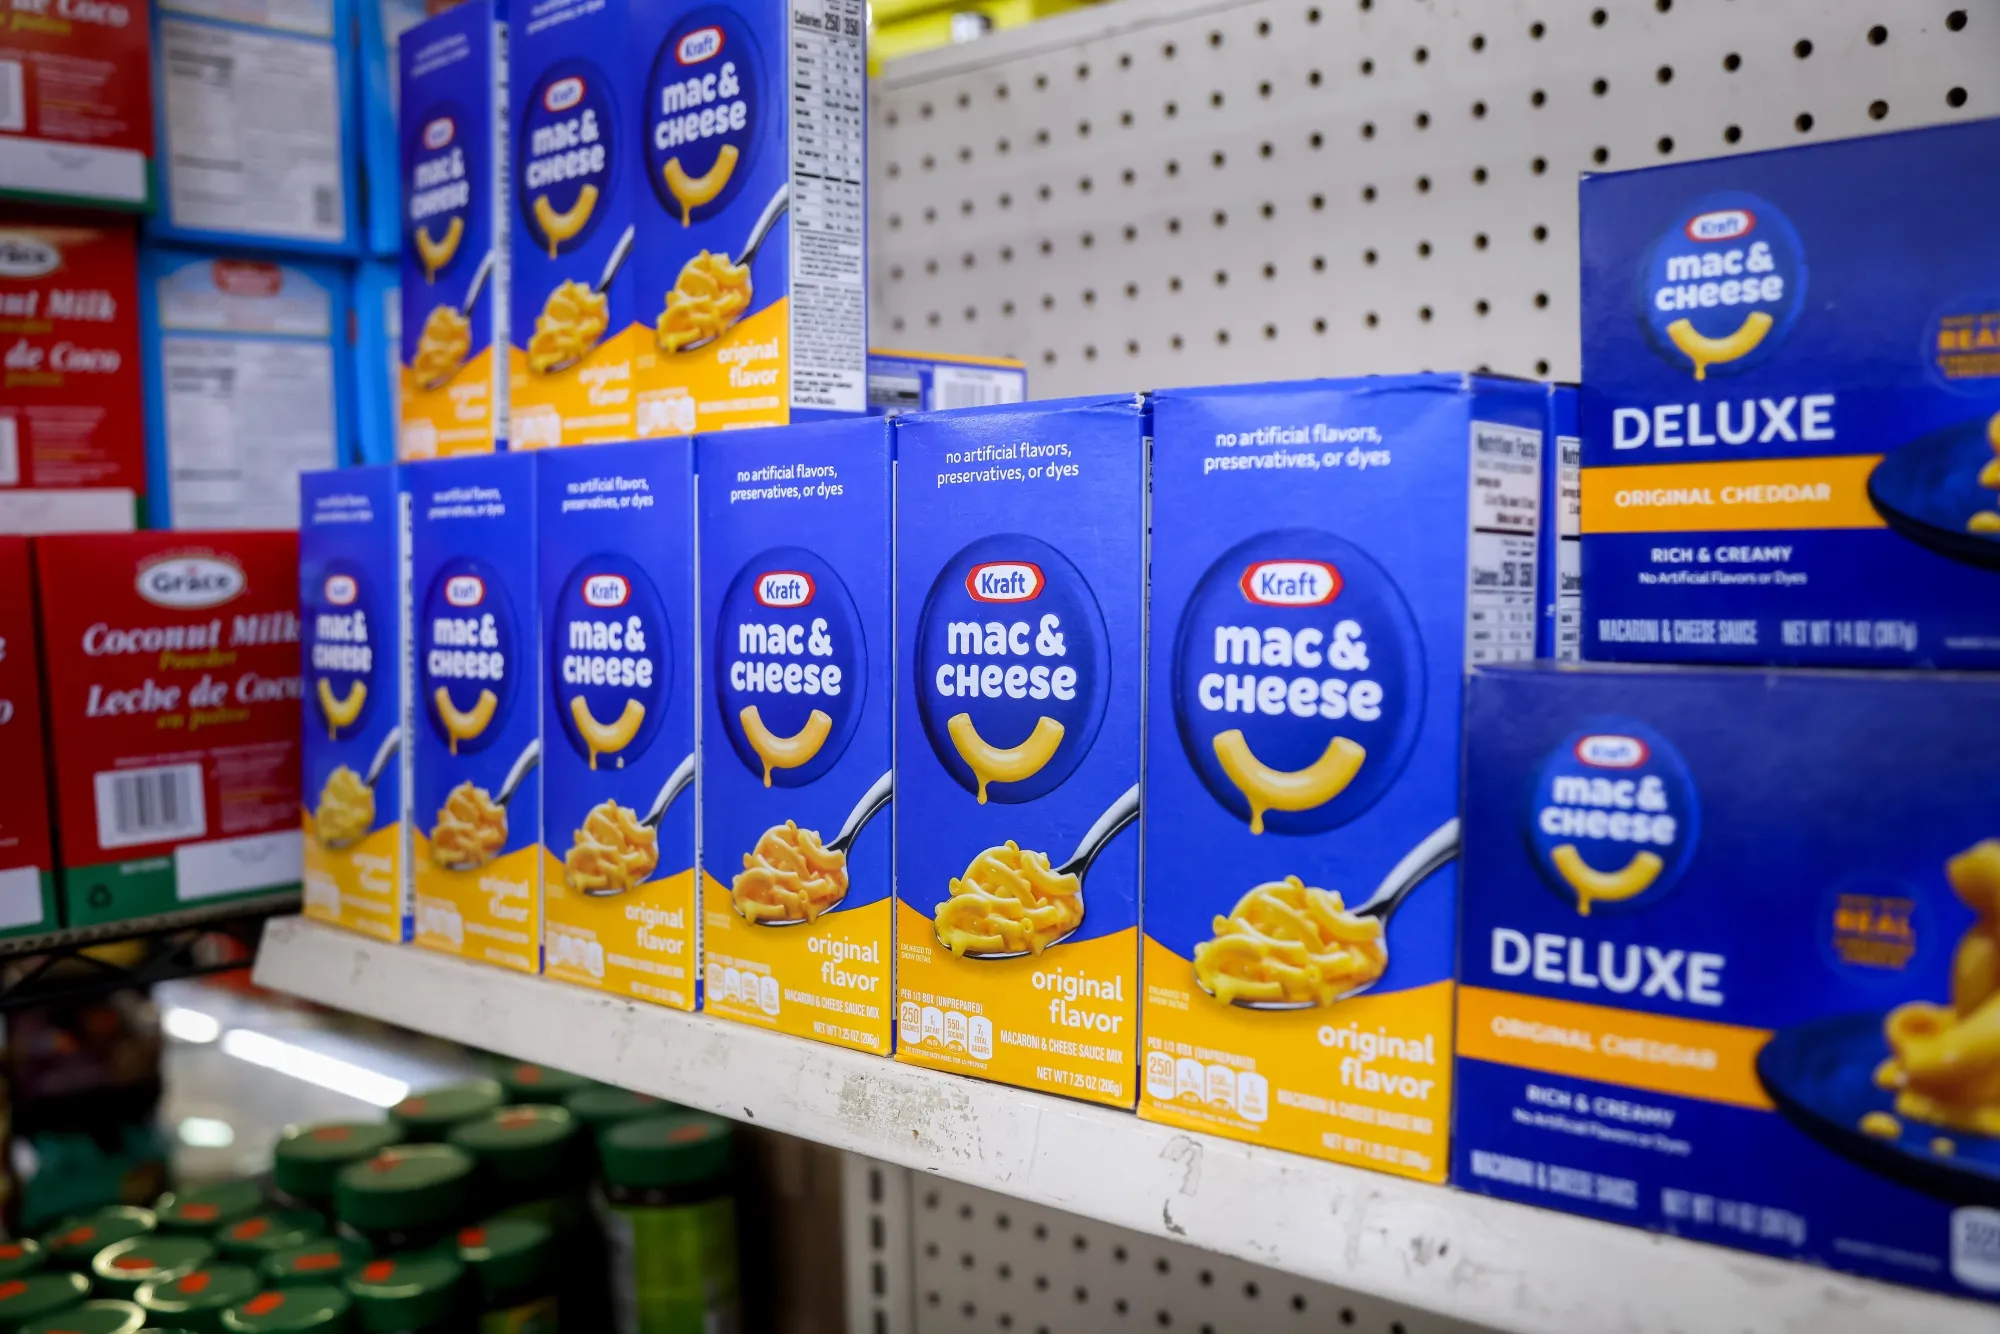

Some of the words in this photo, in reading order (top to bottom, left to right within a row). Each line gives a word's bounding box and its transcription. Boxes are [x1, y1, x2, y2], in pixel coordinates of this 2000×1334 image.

[662, 72, 716, 115] mac
[717, 61, 740, 98] &
[532, 119, 579, 156] mac
[580, 108, 599, 143] &
[1701, 215, 1739, 236] Kraft
[1666, 246, 1743, 282] mac
[1745, 241, 1774, 274] &
[717, 337, 779, 367] original
[729, 366, 779, 388] flavor
[1216, 431, 1236, 447] no
[1239, 426, 1309, 446] artificial
[1313, 424, 1381, 443] flavors,
[1612, 394, 1836, 450] DELUXE
[946, 450, 961, 464] no
[964, 444, 1017, 462] artificial
[1020, 442, 1072, 458] flavors,
[1204, 450, 1321, 474] preservatives,
[1323, 451, 1341, 466] or
[1346, 447, 1391, 470] dyes
[737, 470, 750, 482] no
[752, 465, 794, 482] artificial
[797, 464, 837, 478] flavors,
[937, 465, 1025, 488] preservatives,
[1028, 465, 1043, 478] or
[1046, 462, 1079, 481] dyes
[731, 485, 801, 504] preservatives,
[803, 485, 815, 497] or
[817, 482, 843, 500] dyes
[1615, 487, 1715, 507] ORIGINAL
[1720, 482, 1831, 505] CHEDDAR
[1651, 548, 1692, 563] RICH
[1697, 548, 1711, 563] &
[1714, 546, 1793, 563] CREAMY
[592, 583, 619, 600] Kraft
[766, 580, 800, 599] Kraft
[982, 571, 1025, 594] Kraft
[1261, 572, 1317, 595] Kraft
[82, 618, 222, 657] Coconut
[433, 618, 479, 646] mac
[479, 613, 498, 647] &
[569, 620, 623, 651] mac
[624, 615, 646, 652] &
[739, 623, 804, 656] mac
[808, 617, 833, 657] &
[948, 621, 1030, 655] mac
[1035, 613, 1066, 656] &
[1215, 626, 1323, 668] mac
[1327, 619, 1369, 671] &
[86, 678, 181, 717] Leche
[189, 674, 228, 707] de
[1552, 775, 1635, 810] mac
[1636, 775, 1668, 811] &
[625, 902, 684, 929] original
[636, 926, 684, 954] flavor
[807, 933, 879, 963] original
[821, 961, 879, 992] flavor
[1491, 927, 1725, 1006] DELUXE
[901, 988, 911, 998] PER
[922, 993, 934, 1004] BOX
[1031, 967, 1123, 1001] original
[821, 996, 844, 1012] CHEESE
[844, 1001, 865, 1017] SAUCE
[902, 1006, 918, 1024] 250
[1049, 999, 1123, 1033] flavor
[1000, 1029, 1039, 1049] MACARONI
[1041, 1037, 1047, 1050] &
[1049, 1038, 1077, 1056] CHEESE
[1079, 1044, 1104, 1061] SAUCE
[1107, 1048, 1123, 1064] MIX
[1317, 1022, 1434, 1064] original
[1037, 1066, 1052, 1080] NET
[1054, 1069, 1068, 1084] WT
[1086, 1076, 1096, 1090] OZ
[1150, 1056, 1171, 1077] 250
[1340, 1056, 1434, 1100] flavor
